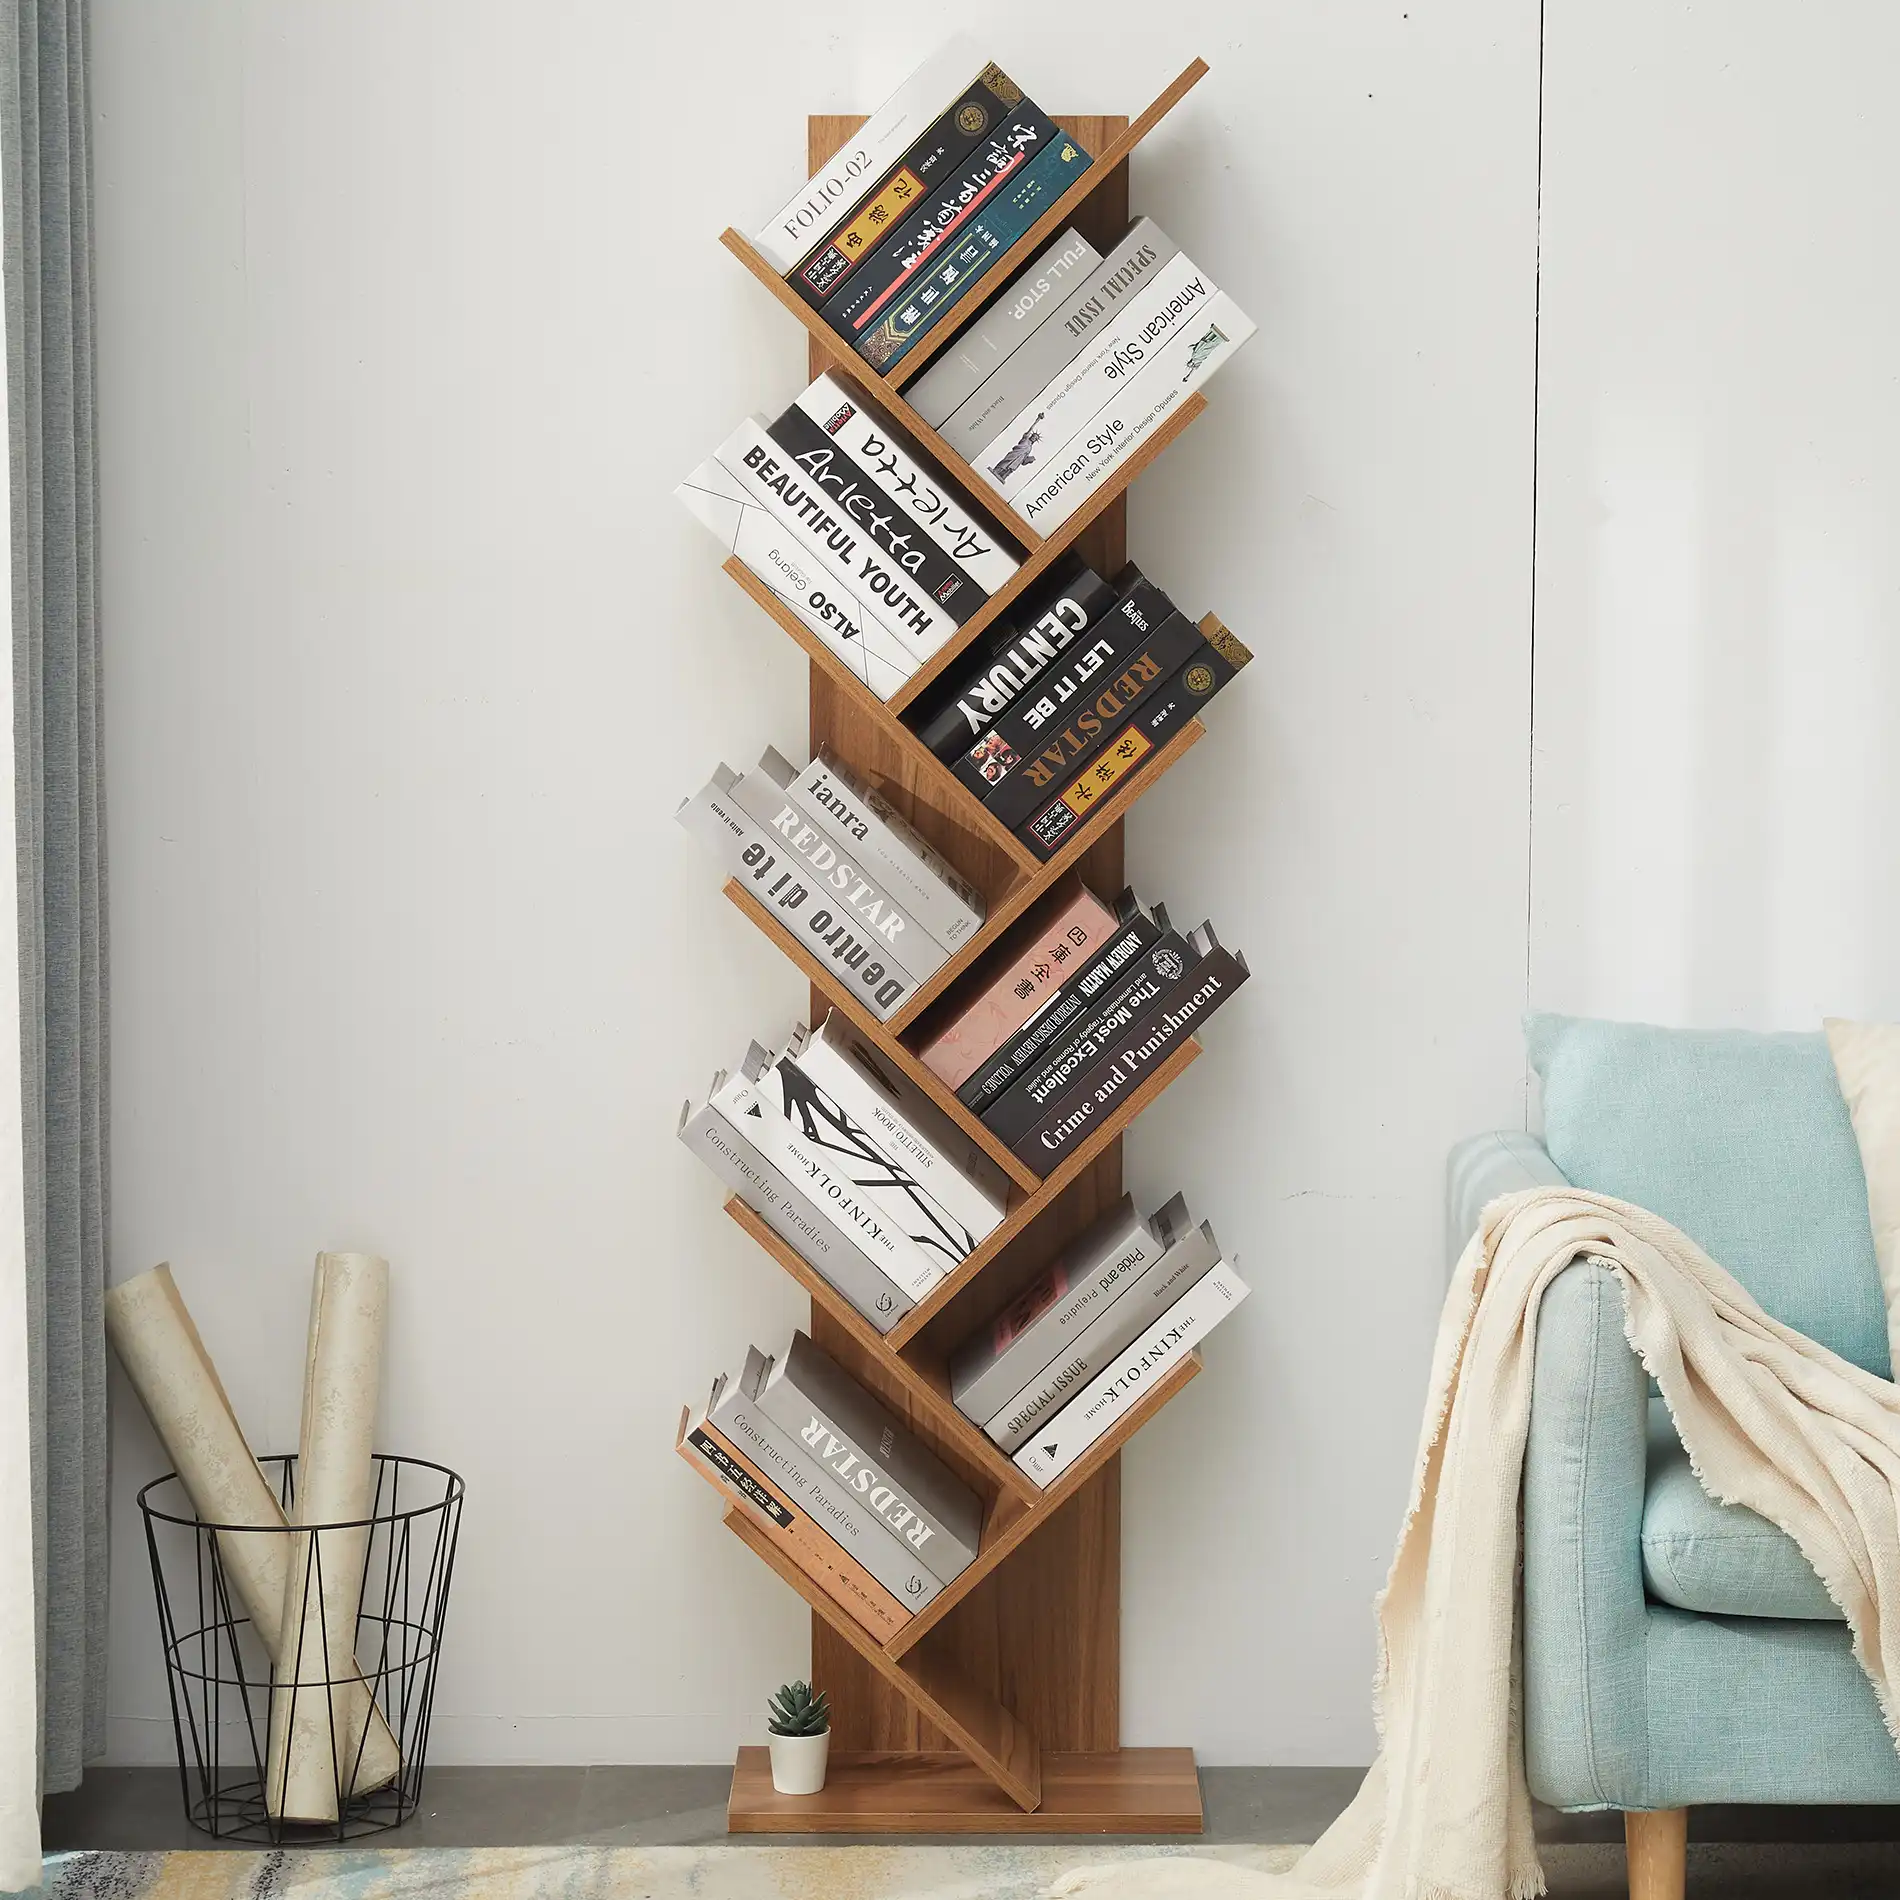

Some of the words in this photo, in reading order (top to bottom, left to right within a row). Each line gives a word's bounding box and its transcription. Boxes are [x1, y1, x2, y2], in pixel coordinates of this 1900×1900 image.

[783, 150, 873, 240] FOLIO-02
[846, 177, 912, 249] 西游记
[807, 248, 838, 280] 中国古典
[816, 258, 847, 288] 文学名著
[1047, 240, 1087, 278] FULL
[1100, 244, 1157, 301] SPECIAL
[1008, 278, 1050, 320] STOP.
[1064, 295, 1106, 338] ISSUE
[1138, 276, 1206, 344] American
[1095, 347, 1110, 359] York
[1107, 334, 1121, 348] New
[1079, 357, 1099, 377] Interior
[1104, 342, 1144, 379] Style
[989, 394, 1005, 409] Black
[1045, 390, 1066, 411] Opuses
[1062, 373, 1083, 393] Design
[967, 416, 984, 431] White
[980, 407, 992, 419] and
[1084, 467, 1101, 482] New
[1097, 452, 1113, 467] York
[1111, 431, 1135, 455] Interior
[1131, 411, 1156, 434] Design
[1152, 388, 1179, 413] Opuses
[1025, 454, 1090, 519] American
[1086, 419, 1124, 455] Style
[794, 449, 926, 575] Arletta
[860, 433, 992, 559] Arletta
[742, 444, 857, 565] BEAUTIFUL
[858, 556, 934, 636] YOUTH
[768, 548, 807, 591] Gelang
[808, 591, 860, 640] ALSO
[956, 598, 1088, 735] CENTURY
[1073, 639, 1115, 683] LET
[1052, 674, 1078, 703] IT
[1021, 651, 1164, 787] REDSTAR
[1022, 695, 1058, 731] BE
[1074, 739, 1138, 801] 水浒传
[807, 774, 869, 842] ianra
[1035, 802, 1065, 833] 中国古典
[1043, 811, 1073, 841] 文学名著
[741, 842, 776, 881] te
[769, 803, 905, 944] REDSTAR
[767, 872, 809, 910] di
[808, 909, 906, 1010] Dentro
[1105, 931, 1143, 971] ANDREW
[1077, 961, 1114, 998] MARTIN
[1127, 980, 1161, 1007] The
[1133, 971, 1147, 987] and
[1049, 993, 1082, 1026] INTERIOR
[1102, 983, 1137, 1017] Lamentable
[1030, 1018, 1058, 1046] DESIGN
[1071, 1037, 1081, 1048] of
[1077, 1015, 1105, 1040] Tragedy
[1092, 1005, 1133, 1044] Most
[1010, 1038, 1038, 1067] REVIEW
[1039, 1063, 1054, 1079] and
[1041, 1102, 1094, 1149] Crime
[1094, 1064, 1128, 1103] and
[1120, 975, 1222, 1072] Punishment
[1051, 1043, 1076, 1066] Romeo
[980, 1083, 992, 1095] 9
[984, 1063, 1015, 1092] VOLUME
[1024, 1074, 1042, 1093] Juliet
[1031, 1039, 1099, 1104] Excellent
[872, 1106, 896, 1132] BOOK
[787, 1143, 810, 1166] HOME
[895, 1131, 934, 1169] STILETTO
[705, 1128, 779, 1203] Constructing
[780, 1201, 831, 1253] Paradies
[805, 1162, 883, 1239] KINFOLK
[879, 1235, 895, 1251] THE
[1115, 1246, 1146, 1273] Pride
[1097, 1268, 1120, 1293] and
[1152, 1283, 1168, 1298] Black
[1166, 1273, 1177, 1286] and
[1172, 1263, 1190, 1277] White
[1059, 1288, 1099, 1325] Prejudice
[1178, 1315, 1195, 1331] THE
[1102, 1327, 1183, 1403] KINFOLK
[1007, 1389, 1056, 1435] SPECIAL
[1051, 1357, 1088, 1393] ISSUE
[1084, 1397, 1108, 1419] HOME
[699, 1439, 783, 1518] 四书五经详解
[733, 1414, 808, 1488] Constructing
[809, 1485, 860, 1536] Paradies
[800, 1415, 936, 1550] REDSTAR
